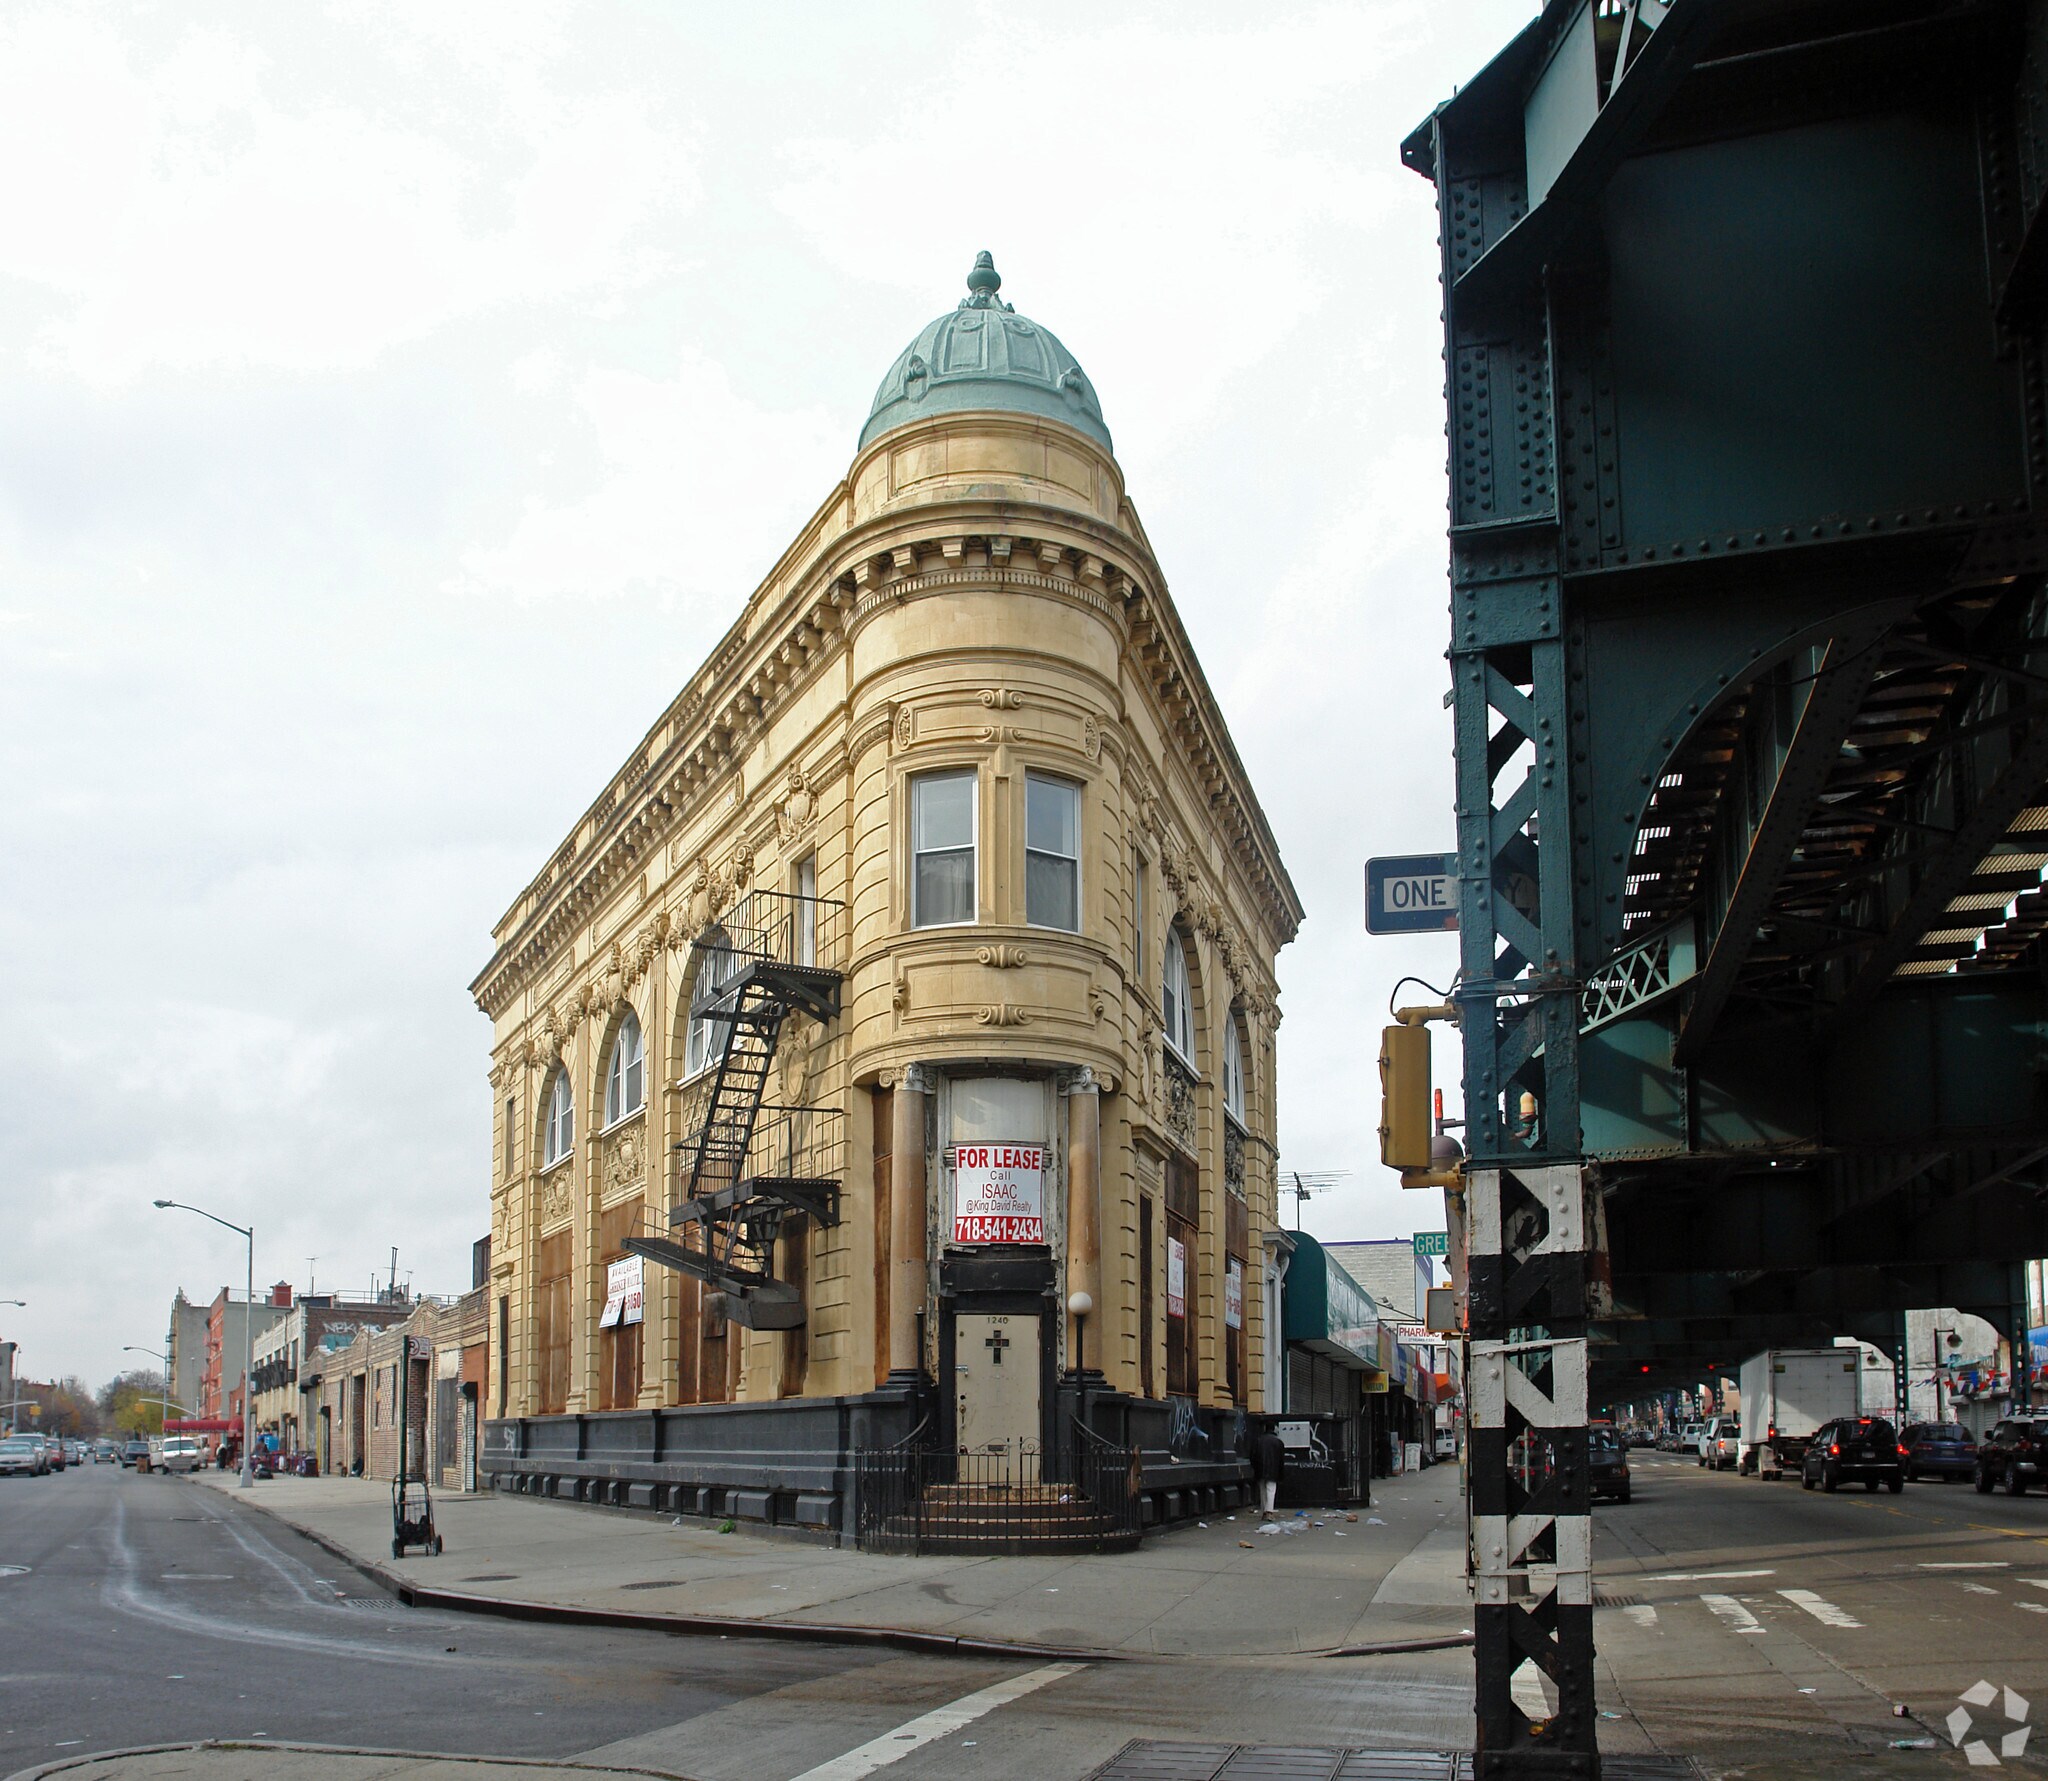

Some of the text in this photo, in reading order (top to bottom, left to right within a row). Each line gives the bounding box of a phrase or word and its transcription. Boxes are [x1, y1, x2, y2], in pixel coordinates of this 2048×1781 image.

[1393, 879, 1446, 908] ONE
[958, 1148, 1040, 1170] FOR LEASE
[990, 1170, 1011, 1181] Call
[982, 1183, 1018, 1199] ISAAC
[966, 1200, 1032, 1215] @King David Realty
[957, 1217, 1042, 1241] 718-541-2434
[987, 1316, 1009, 1325] 1240
